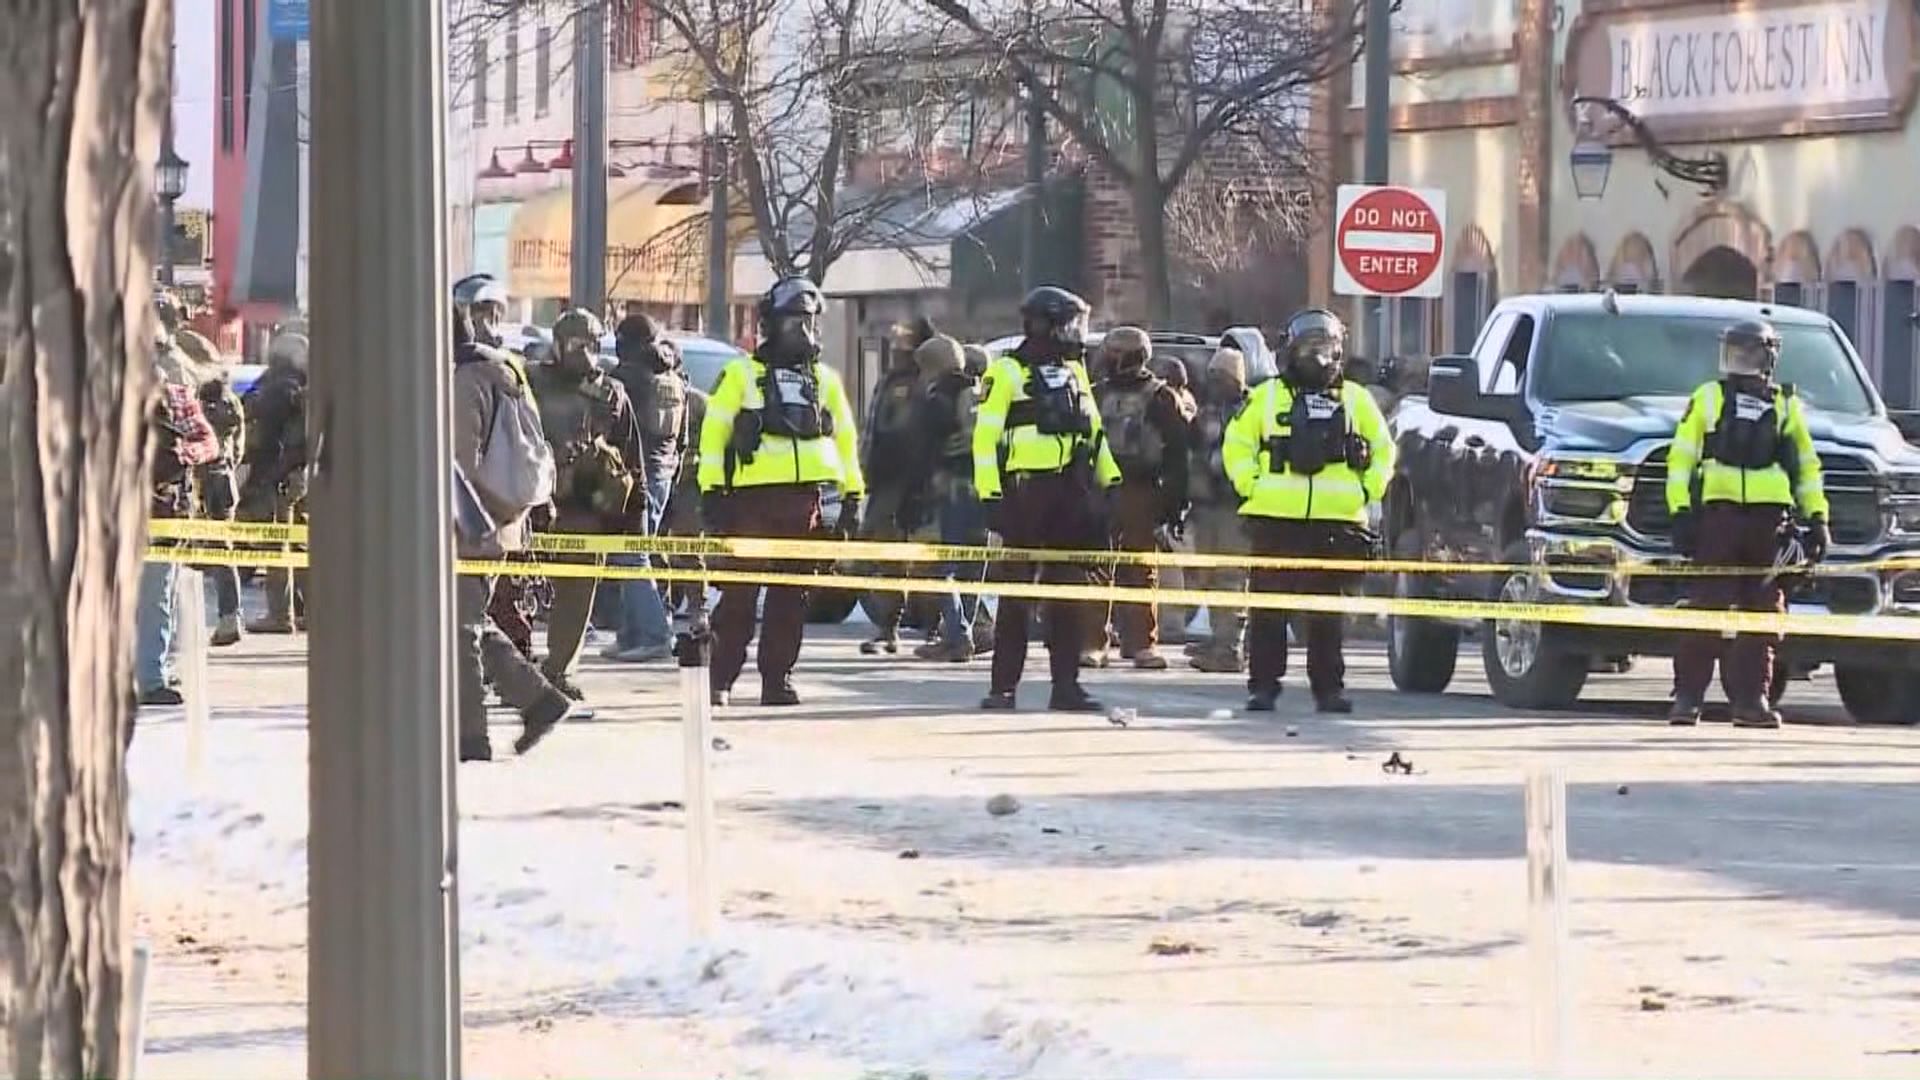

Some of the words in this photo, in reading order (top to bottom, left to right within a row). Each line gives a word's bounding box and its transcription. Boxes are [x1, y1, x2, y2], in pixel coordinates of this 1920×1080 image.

[1620, 32, 1702, 100] BLACK
[1710, 24, 1815, 96] FOREST
[1821, 15, 1876, 86] INN
[1354, 208, 1380, 225] DO
[1391, 209, 1429, 228] NOT
[1359, 256, 1418, 275] ENTER
[262, 527, 289, 540] CROSS
[540, 537, 557, 549] NOT
[558, 538, 586, 550] CROSS
[624, 539, 652, 551] POLICE
[654, 540, 673, 552] LINE
[676, 541, 688, 553] DO
[689, 541, 706, 553] NOT
